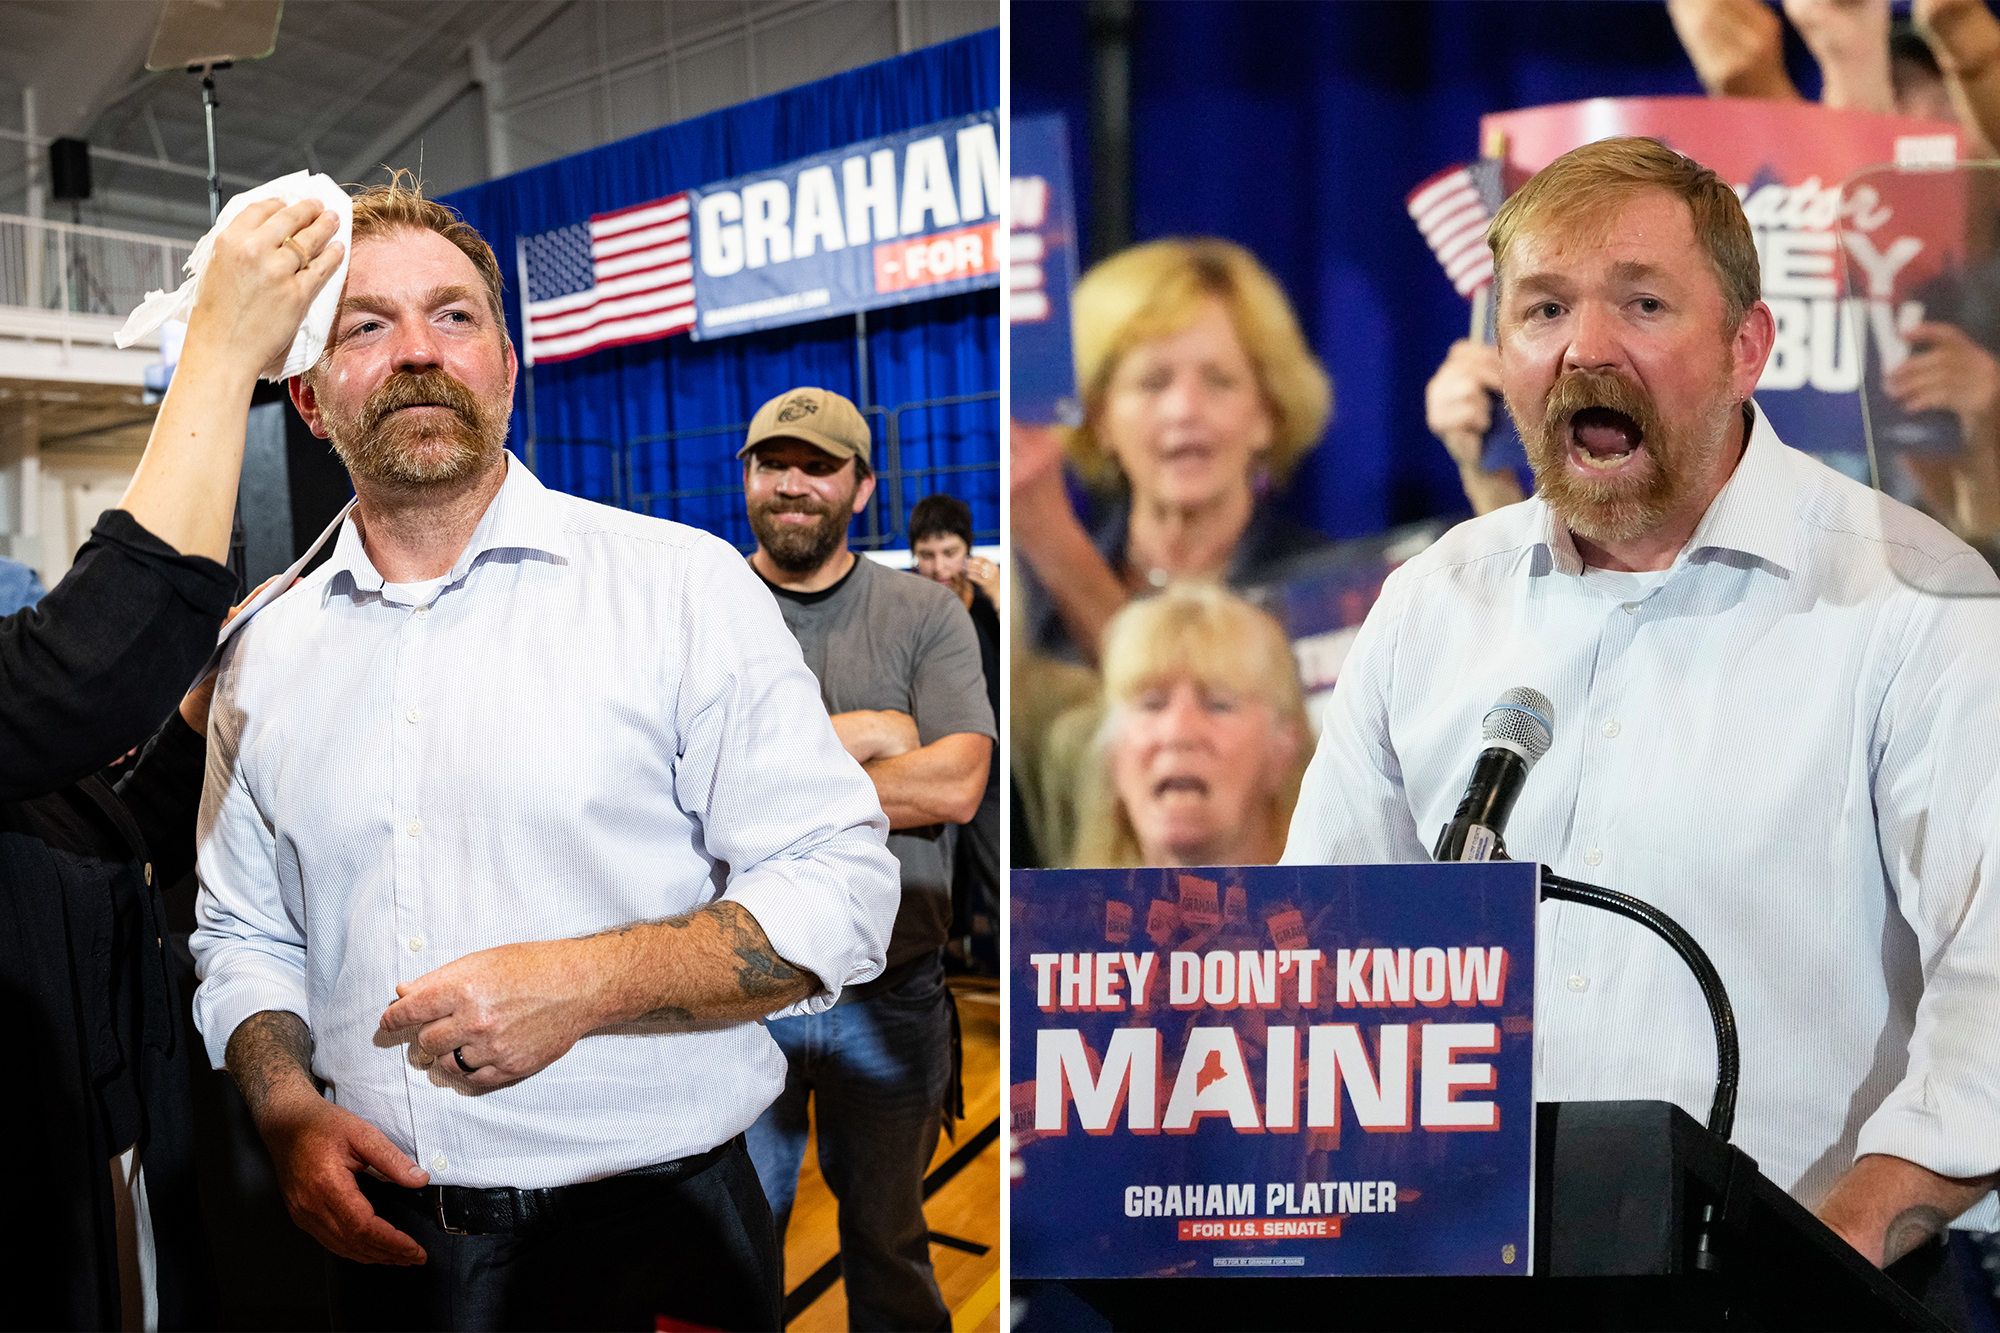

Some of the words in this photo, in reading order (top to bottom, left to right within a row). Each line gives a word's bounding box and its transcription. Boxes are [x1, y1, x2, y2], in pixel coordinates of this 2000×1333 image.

[700, 122, 1000, 278] GRAHAM
[905, 234, 983, 280] FOR
[1030, 952, 1154, 1007] THEY
[1169, 949, 1320, 1005] DON'T
[1336, 946, 1503, 1003] KNOW
[1034, 1022, 1496, 1130] MAINE
[1124, 1184, 1255, 1217] GRAHAM
[1267, 1181, 1397, 1215] PLATNER
[1192, 1223, 1225, 1238] FOR
[1229, 1222, 1259, 1237] U.S.
[1263, 1221, 1327, 1236] SENATE
